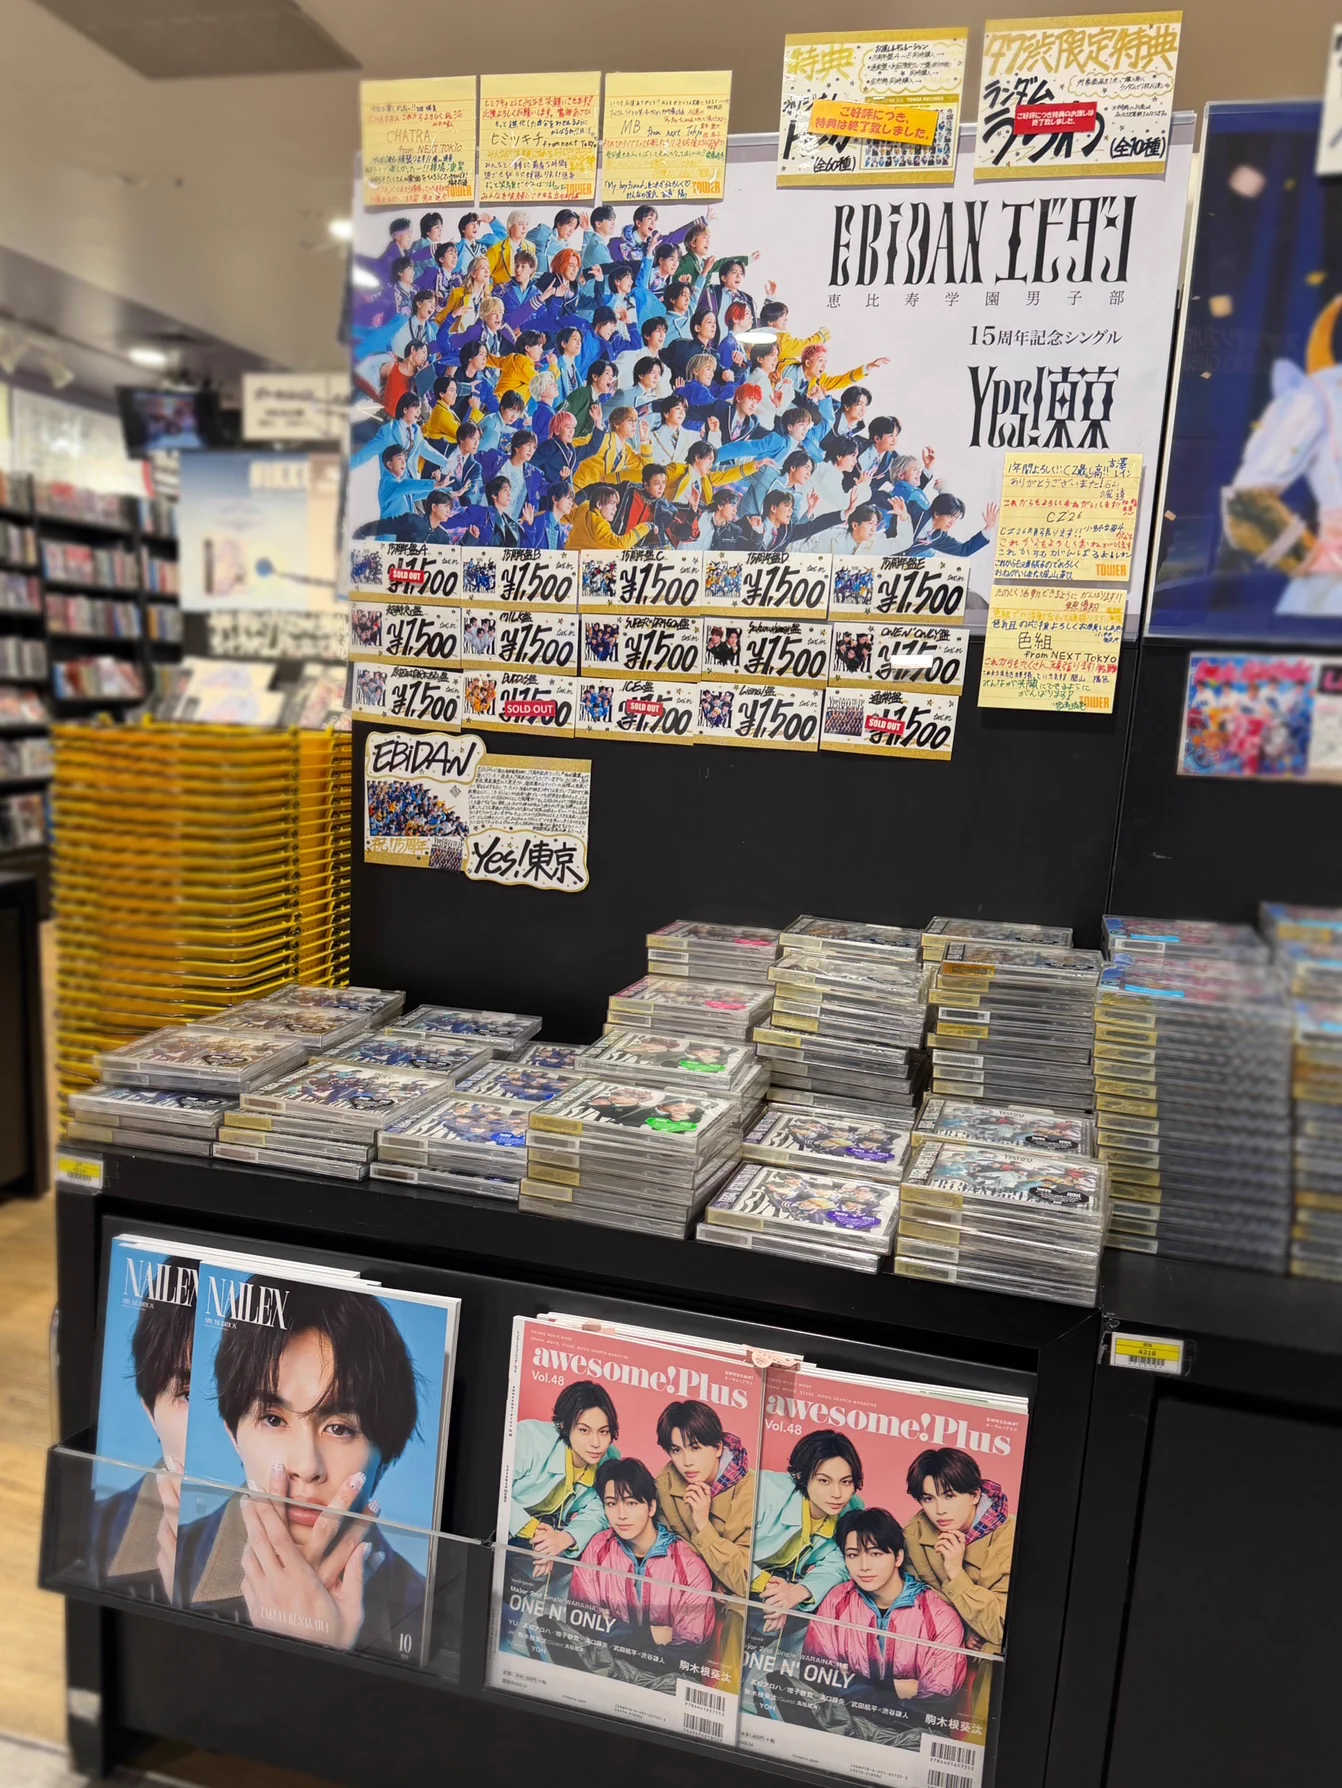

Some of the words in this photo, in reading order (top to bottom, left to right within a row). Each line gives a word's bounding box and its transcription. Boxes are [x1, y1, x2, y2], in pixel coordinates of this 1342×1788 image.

[788, 44, 854, 82] 特典
[839, 106, 910, 124] ご好評につき、
[1016, 109, 1095, 120] ご好評につき特典のお渡しは
[1031, 116, 1077, 127] 終了致しました。
[386, 129, 431, 143] CHATRA
[620, 120, 641, 135] MB
[815, 117, 930, 141] 特典は終了致しました。
[440, 141, 463, 153] TOKYO
[491, 132, 543, 147] ヒミツキチ
[447, 185, 472, 197] TOWER
[566, 183, 592, 195] TOWER
[692, 181, 720, 194] TOWER
[826, 290, 1125, 308] 恵比寿学園男子部
[968, 325, 1122, 347] 15周年記念シングル
[392, 569, 409, 579] SOLD
[408, 572, 422, 581] OUT
[1096, 564, 1127, 577] TOWER
[500, 562, 573, 602] ¥1,500
[620, 563, 699, 606] ¥1,500
[742, 565, 825, 608] ¥1,500
[876, 571, 964, 615] ¥1,500
[386, 617, 457, 659] ¥1,500
[499, 623, 574, 666] ¥1,500
[1018, 631, 1053, 651] 色組
[624, 630, 698, 672] ¥1,500
[743, 635, 827, 678] ¥1,500
[1024, 651, 1049, 659] from
[1050, 651, 1082, 661] NEXT
[391, 680, 458, 722] ¥1,500
[507, 704, 530, 714] SOLD
[533, 705, 553, 714] OUT
[630, 702, 646, 711] SOLD
[646, 704, 660, 713] OUT
[1079, 695, 1110, 709] TOWER
[735, 698, 817, 741] ¥1,500
[868, 718, 886, 728] SOLD
[886, 721, 901, 731] OUT
[372, 739, 478, 778] EBiDAN
[473, 836, 584, 884] Yes!東京
[204, 1275, 291, 1330] NAILEX
[608, 1352, 629, 1360] MAGAZINE
[531, 1369, 565, 1386] Vol.48
[532, 1346, 748, 1409] awesome!Plus
[724, 1370, 754, 1380] awesome!
[833, 1396, 852, 1404] SEARCH
[852, 1399, 877, 1408] MAGAZINE
[764, 1418, 802, 1436] Vol.48
[765, 1394, 1011, 1456] awesome!Plus
[986, 1417, 1019, 1427] awesome!
[510, 1585, 528, 1595] Major
[529, 1590, 542, 1598] 2nd
[509, 1594, 546, 1617] ONE
[548, 1603, 567, 1621] N'
[570, 1609, 617, 1634] ONLY
[531, 1645, 546, 1653] YOH
[759, 1646, 774, 1655] 2nd
[679, 1660, 732, 1683] 駒木根葵汰
[742, 1650, 777, 1673] ONE
[780, 1658, 800, 1677] N'
[803, 1664, 856, 1689] ONLY
[759, 1702, 776, 1711] YOH
[925, 1713, 983, 1735] 駒木根葵汰
